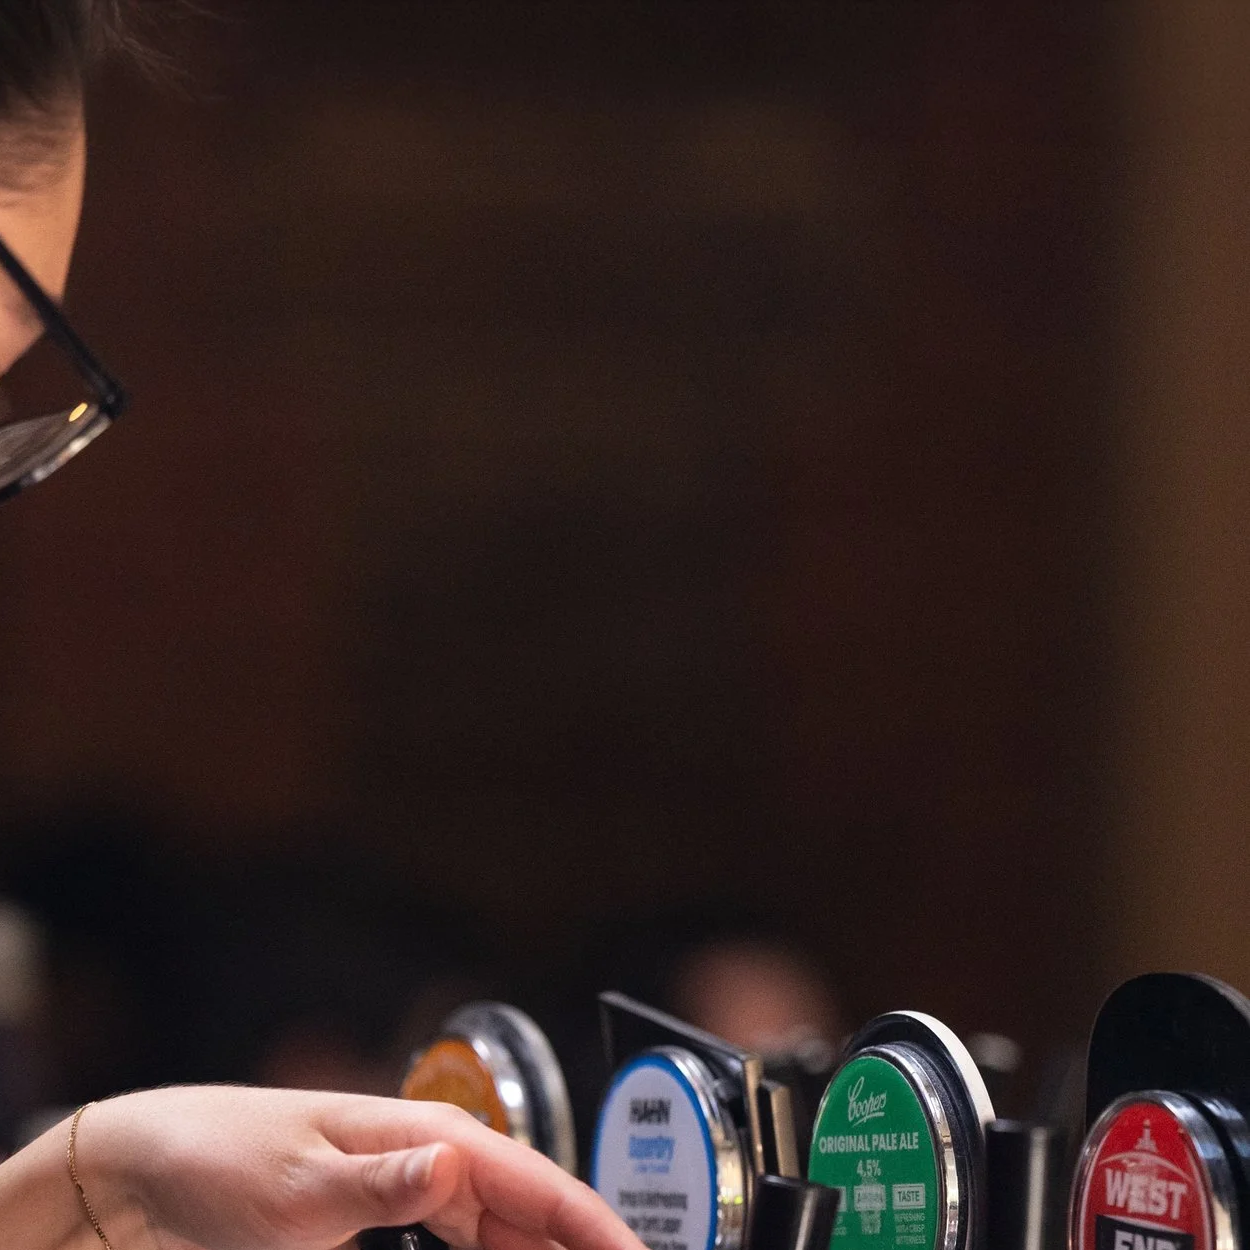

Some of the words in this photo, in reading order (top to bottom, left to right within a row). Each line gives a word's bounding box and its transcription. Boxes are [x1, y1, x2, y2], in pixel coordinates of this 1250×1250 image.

[847, 1076, 888, 1128] Coopers
[819, 1134, 870, 1154] ORIGINAL
[872, 1133, 897, 1151] PALE
[899, 1132, 919, 1150] ALE
[856, 1160, 882, 1178] 4.5%
[898, 1190, 920, 1202] TASTE
[1105, 1168, 1187, 1221] WEST
